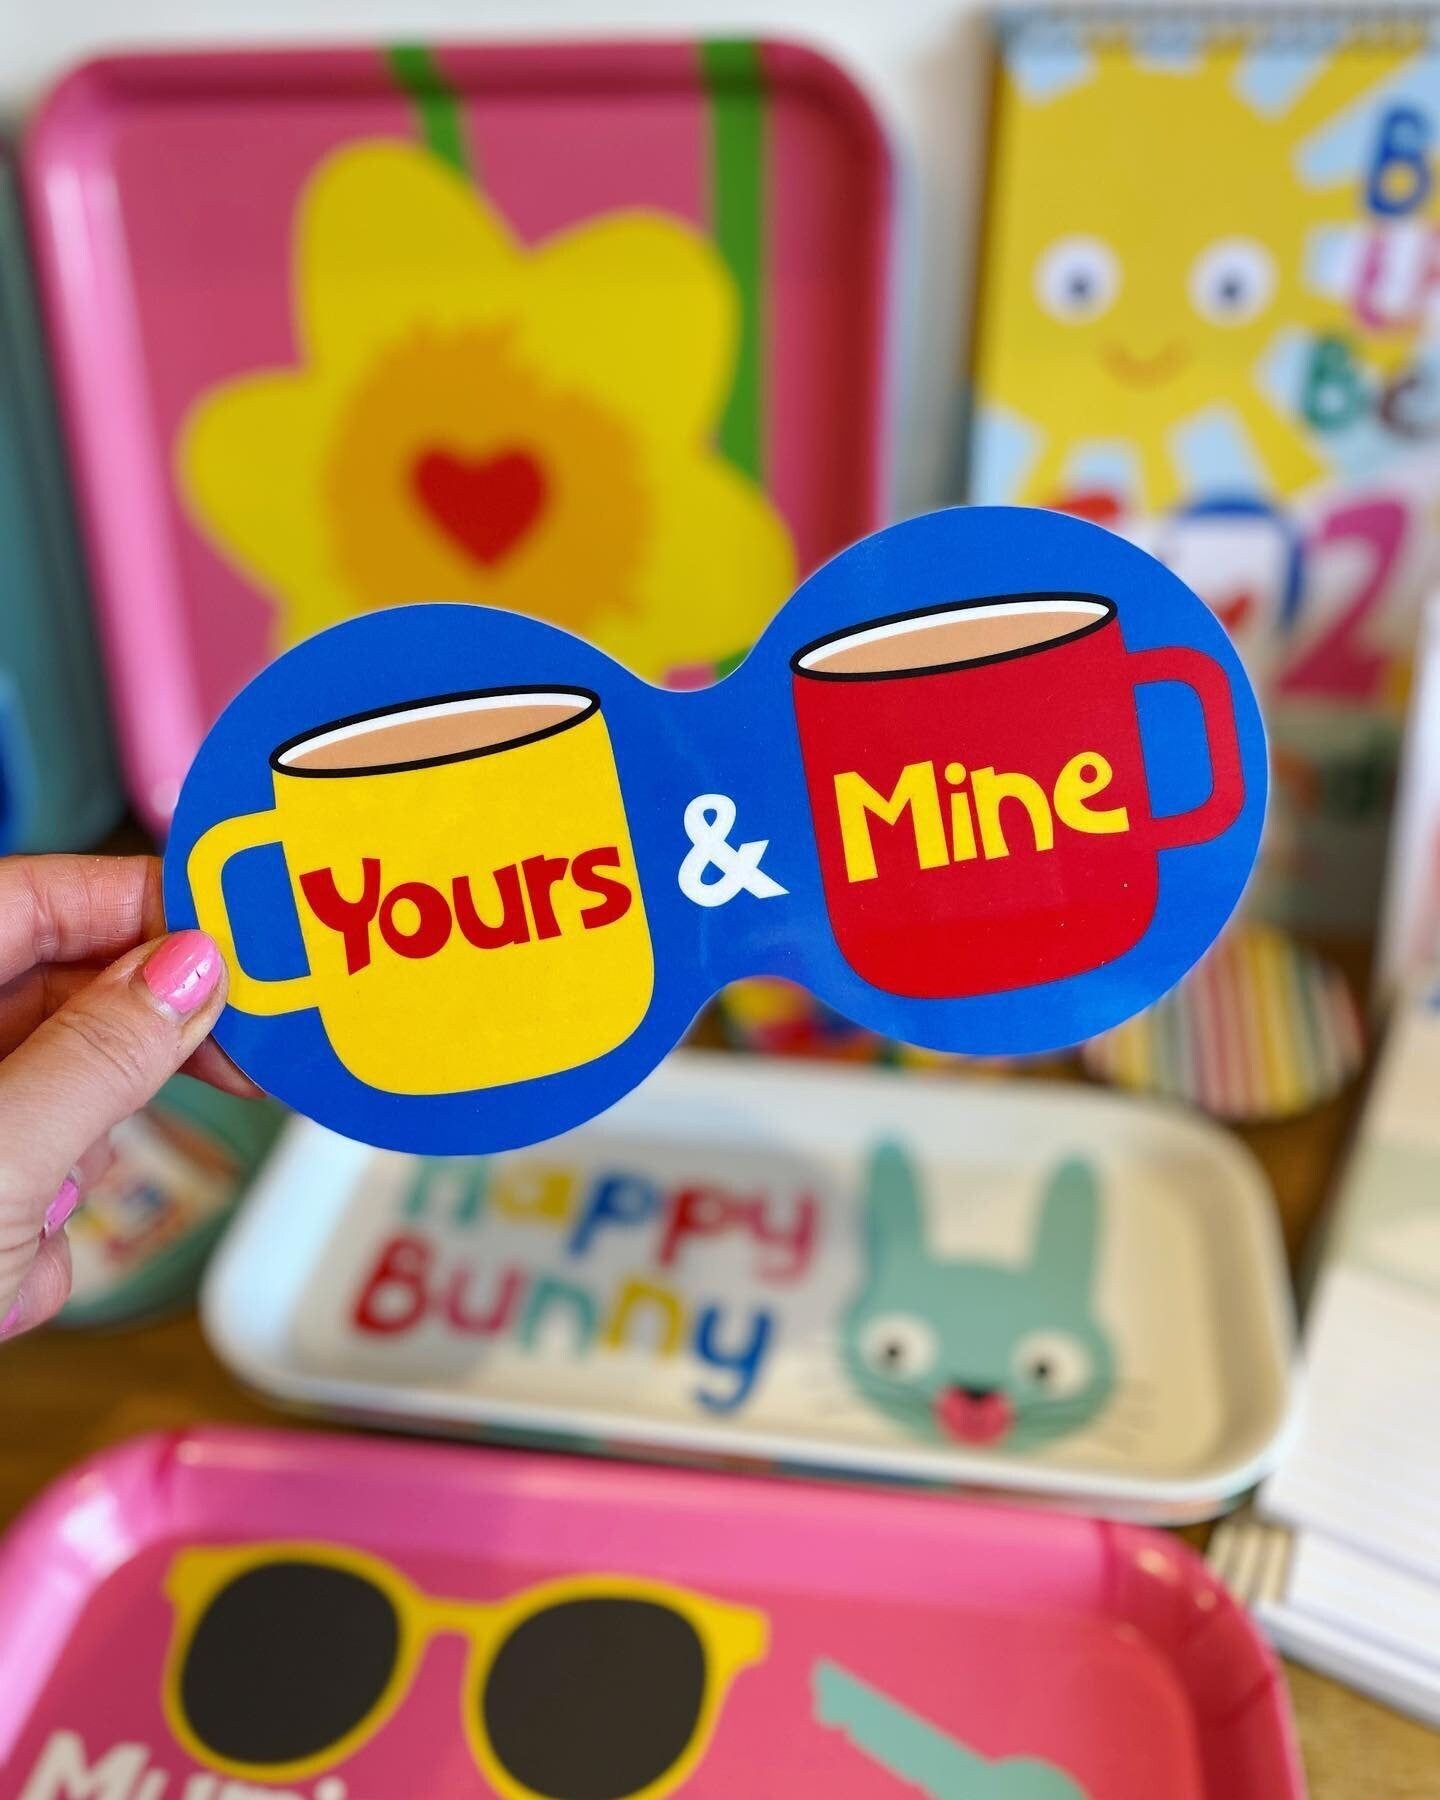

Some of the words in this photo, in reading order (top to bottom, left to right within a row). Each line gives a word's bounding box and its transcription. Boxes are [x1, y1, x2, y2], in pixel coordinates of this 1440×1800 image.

[299, 846, 632, 976] Yours
[678, 793, 787, 907] &
[833, 751, 1130, 883] Mine
[350, 1230, 773, 1414] Bunny
